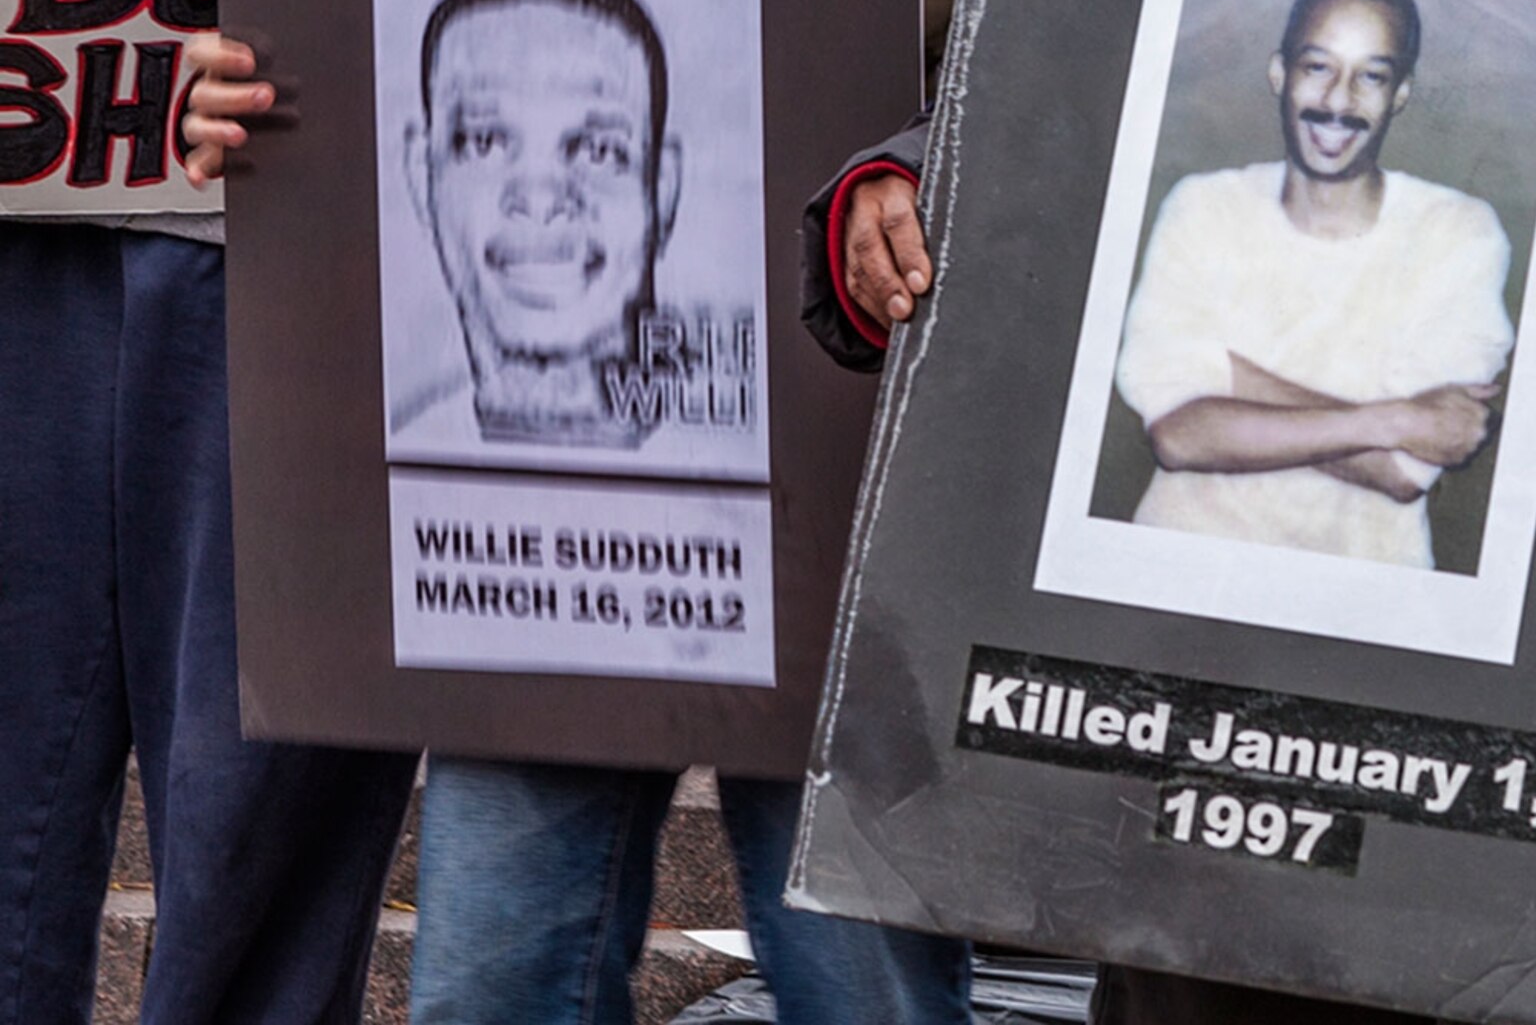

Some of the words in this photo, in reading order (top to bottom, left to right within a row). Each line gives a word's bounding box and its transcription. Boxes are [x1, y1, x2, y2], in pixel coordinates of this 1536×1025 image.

[0, 38, 224, 189] SH
[414, 519, 543, 568] WILLIE
[554, 527, 743, 580] SUDDUTH
[414, 572, 558, 621] MARCH
[571, 583, 633, 632] 16,
[643, 587, 747, 634] 2012
[967, 672, 1171, 754] Killed
[1188, 712, 1472, 814] January
[1163, 787, 1334, 863] 1997
